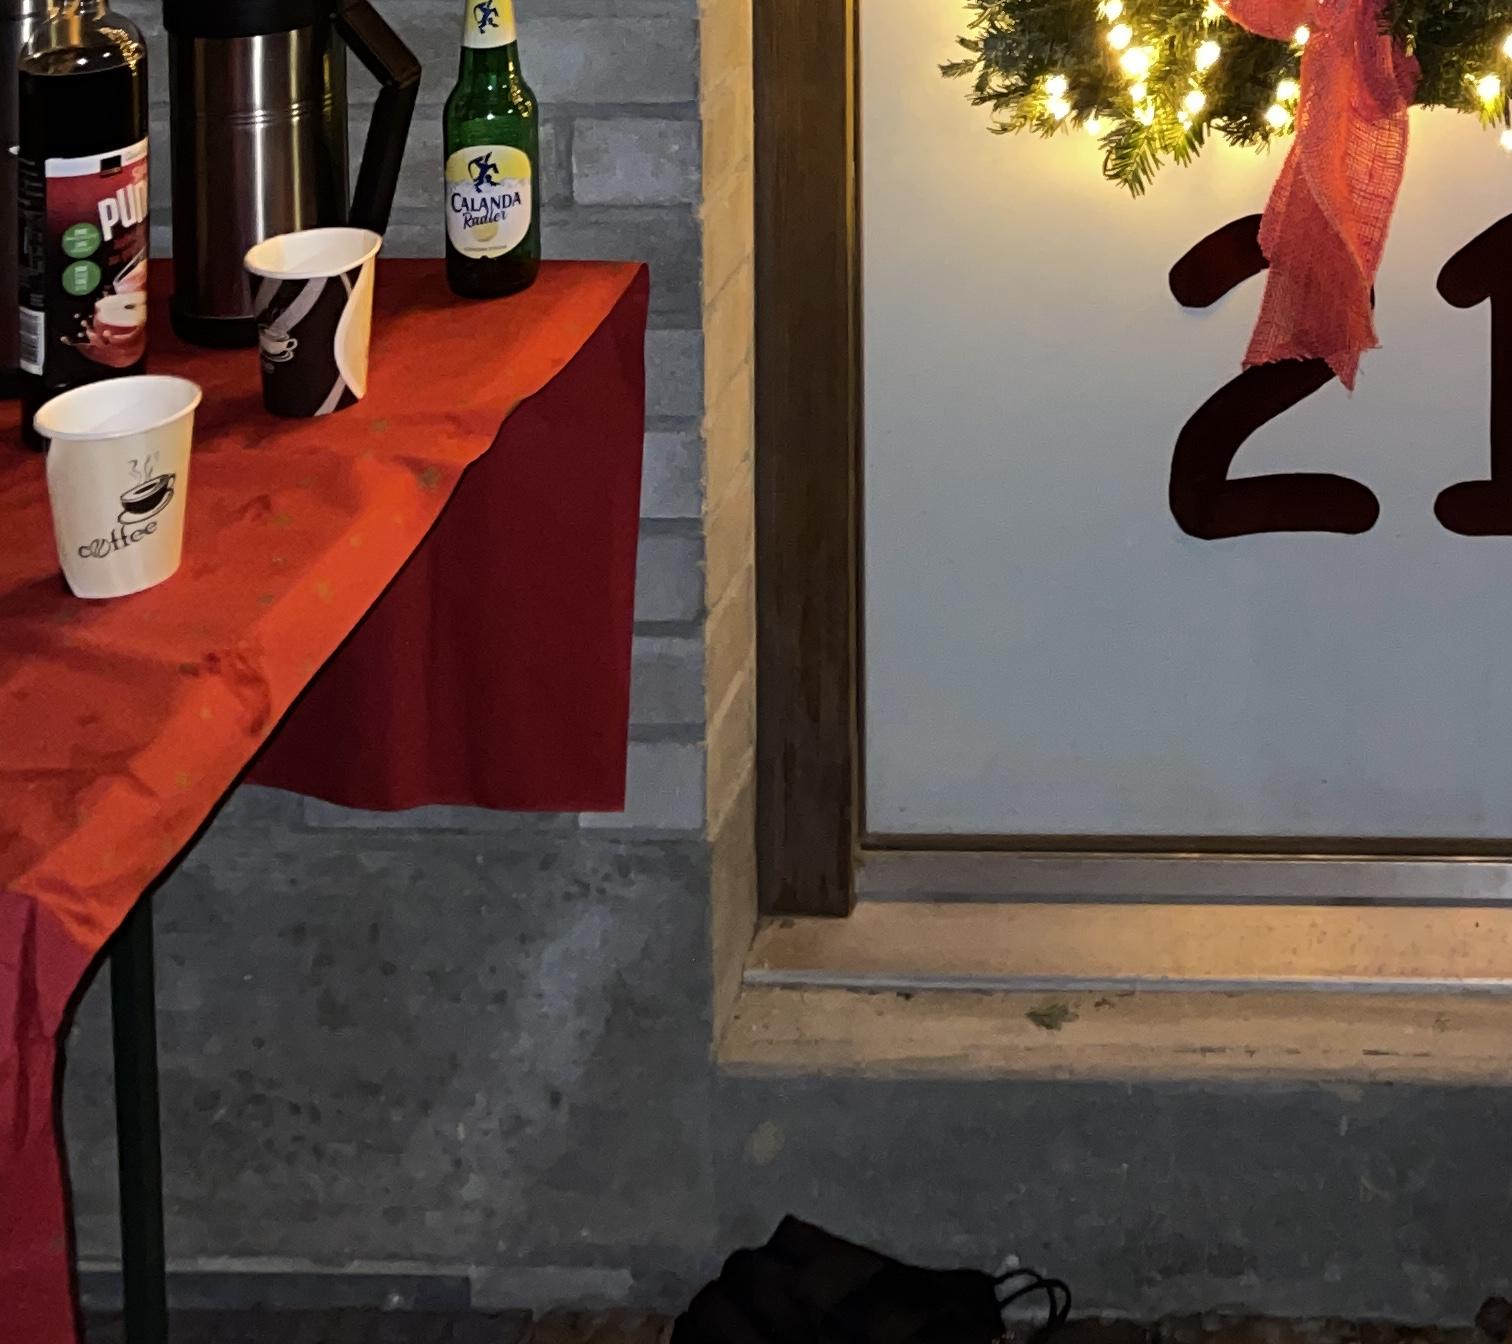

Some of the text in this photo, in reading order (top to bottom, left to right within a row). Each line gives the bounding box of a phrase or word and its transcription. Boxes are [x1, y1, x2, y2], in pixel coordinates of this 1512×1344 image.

[451, 192, 521, 213] CALANDA
[462, 208, 506, 229] Radler
[78, 521, 157, 559] coffee
